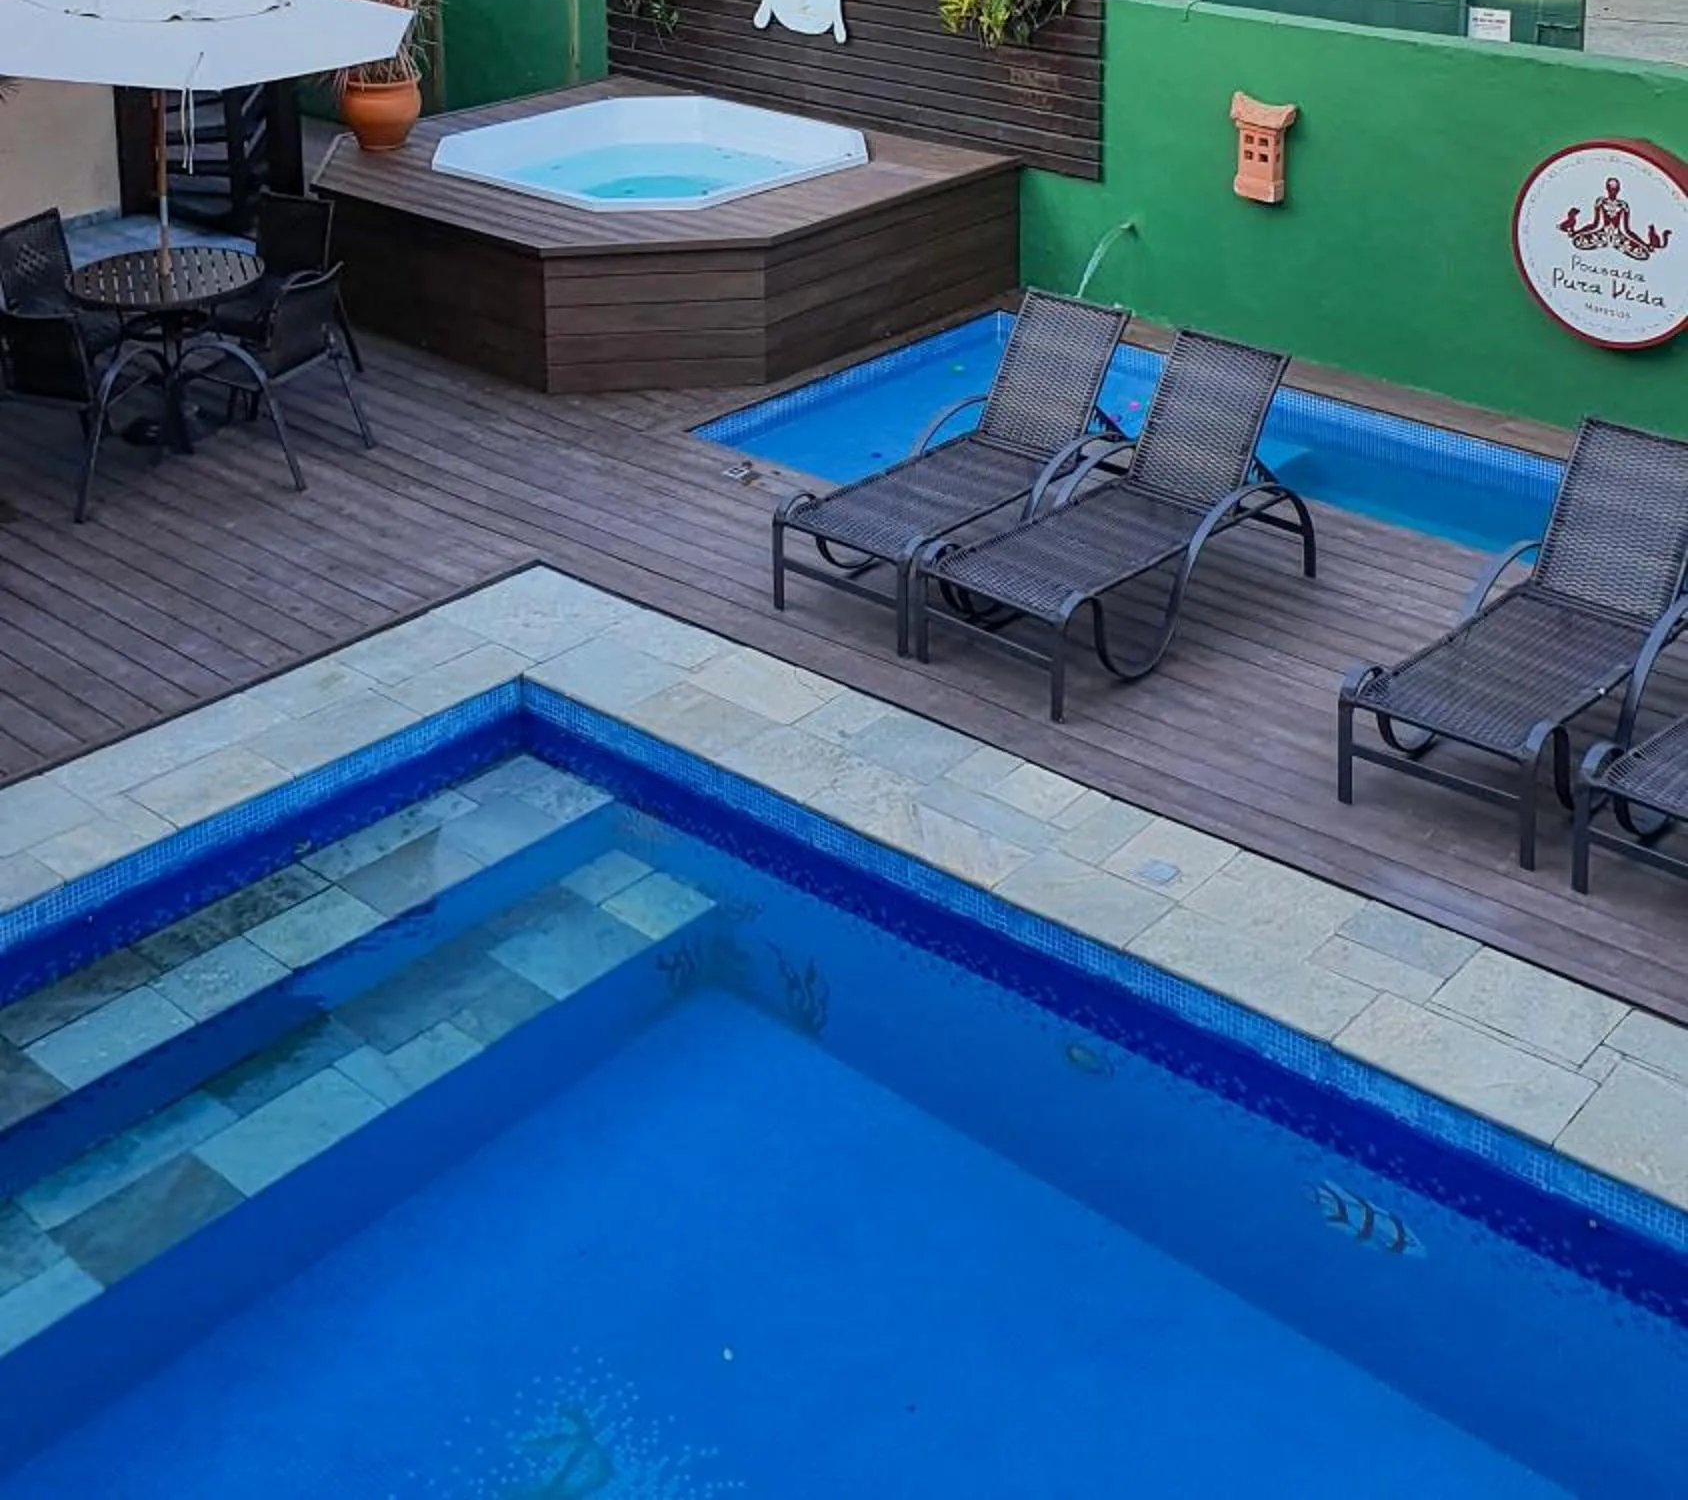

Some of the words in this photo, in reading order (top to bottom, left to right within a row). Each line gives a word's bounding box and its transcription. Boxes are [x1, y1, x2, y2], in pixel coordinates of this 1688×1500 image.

[1571, 254, 1646, 282] Pousada
[1552, 268, 1602, 295] Pura
[1612, 279, 1666, 308] Vida
